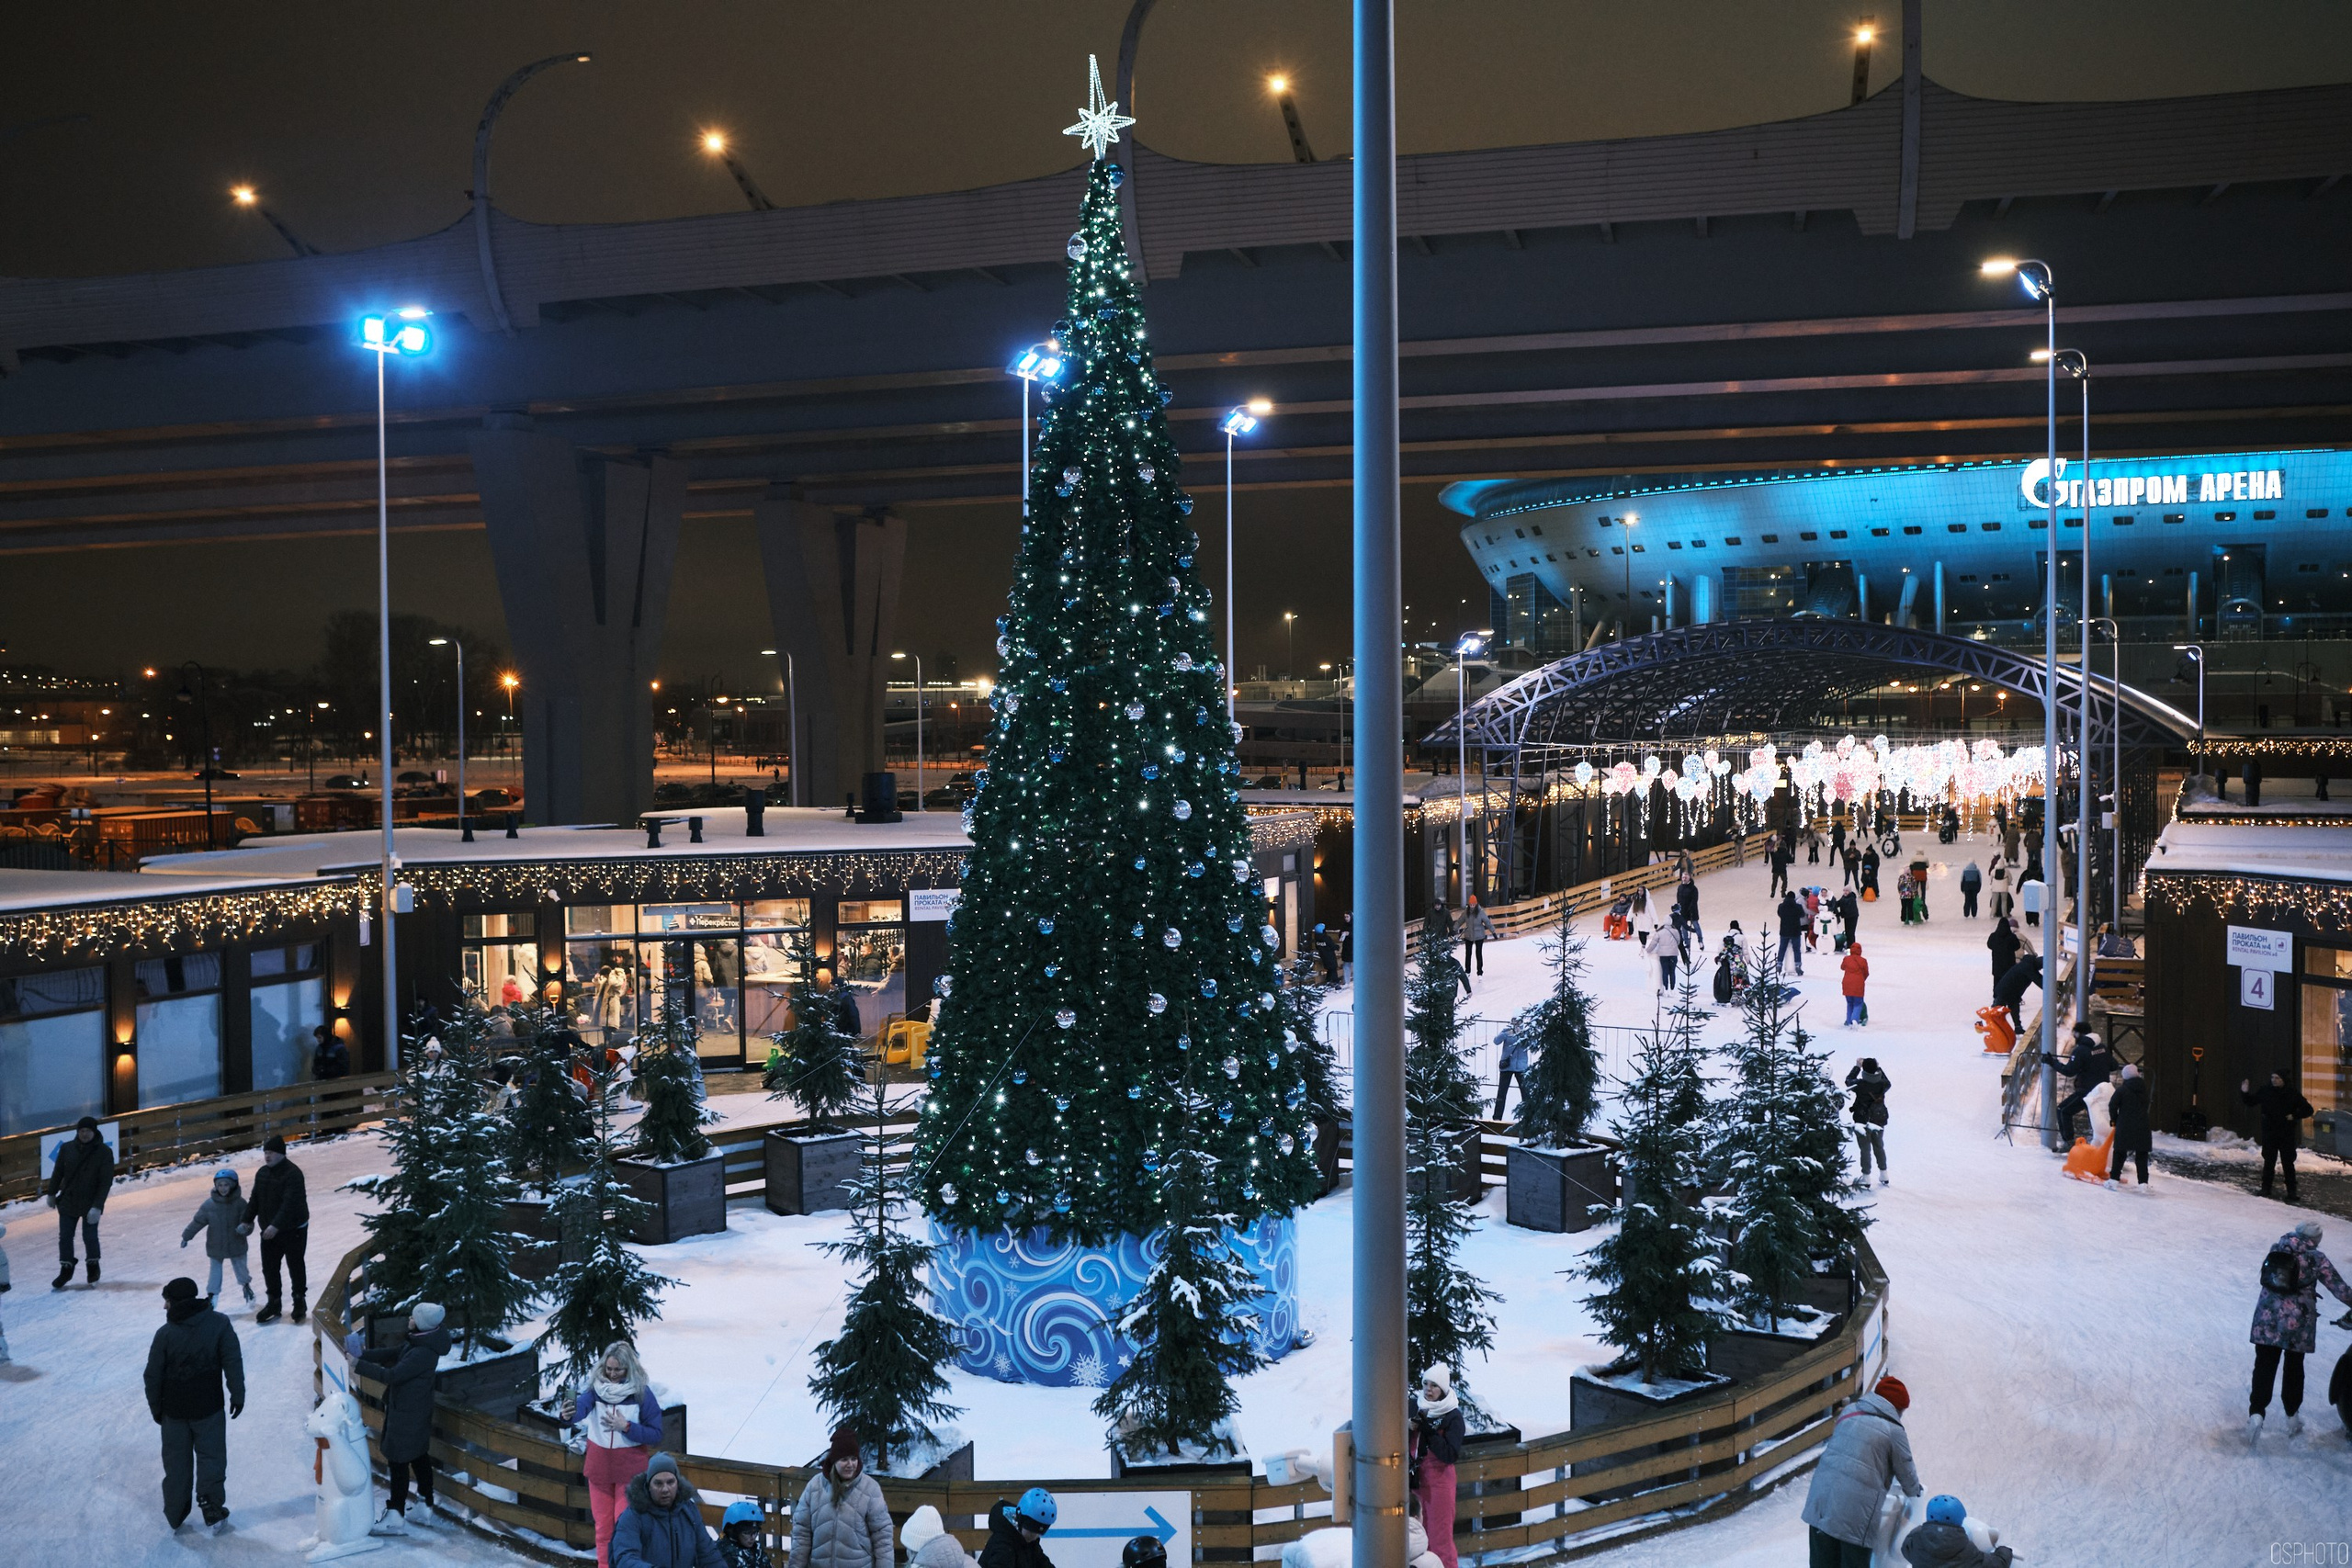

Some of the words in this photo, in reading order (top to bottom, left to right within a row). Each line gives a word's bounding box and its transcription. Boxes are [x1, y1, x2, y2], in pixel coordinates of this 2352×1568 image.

[2070, 475, 2188, 508] ГАЗПРОМ
[2199, 469, 2283, 502] АРЕНА
[696, 919, 740, 927] Перекрёсток
[2233, 932, 2267, 942] ПАВИЛЬОН
[2233, 939, 2260, 949] ПРОКАТА
[2250, 948, 2271, 956] PAVILION
[2251, 977, 2264, 998] 4
